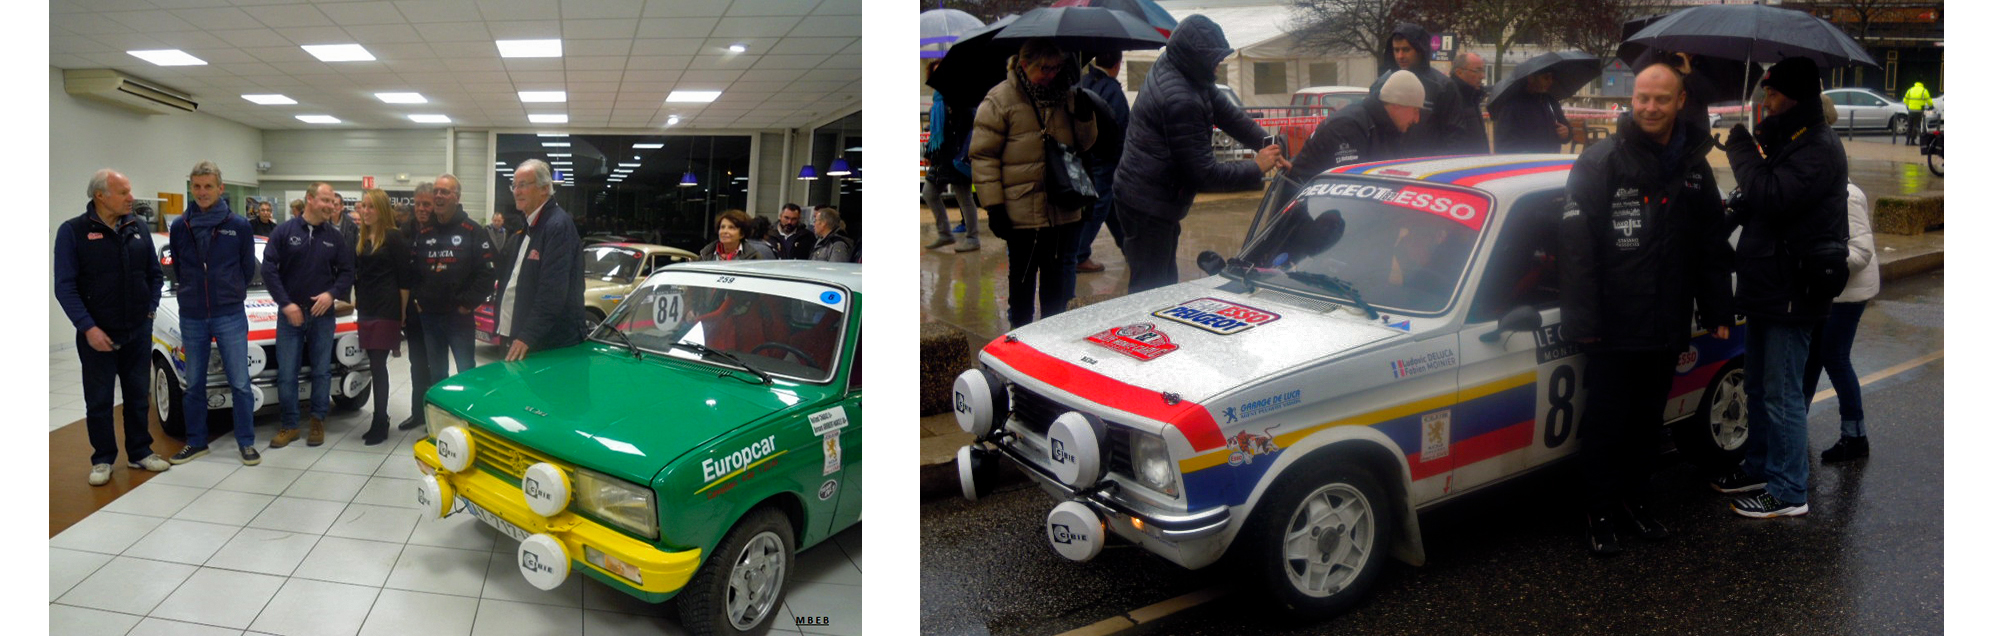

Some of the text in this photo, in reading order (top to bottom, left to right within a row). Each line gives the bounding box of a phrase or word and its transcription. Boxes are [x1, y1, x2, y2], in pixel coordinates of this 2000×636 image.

[1298, 183, 1391, 201] PEUGEOT
[1396, 190, 1476, 220] ESSO
[657, 296, 679, 324] 84
[1163, 306, 1248, 331] PEUGEOT
[1216, 306, 1270, 323] ESSO
[1536, 327, 1556, 347] LE
[1427, 348, 1454, 362] DELUCA
[1405, 357, 1456, 376] Fabien MOINIER
[1241, 397, 1272, 412] GARAGE
[1273, 393, 1283, 404] DE
[701, 434, 775, 483] Europcar
[528, 484, 553, 501] CIBIE
[1058, 531, 1088, 543] CIBIE
[527, 557, 554, 574] CIBIE
